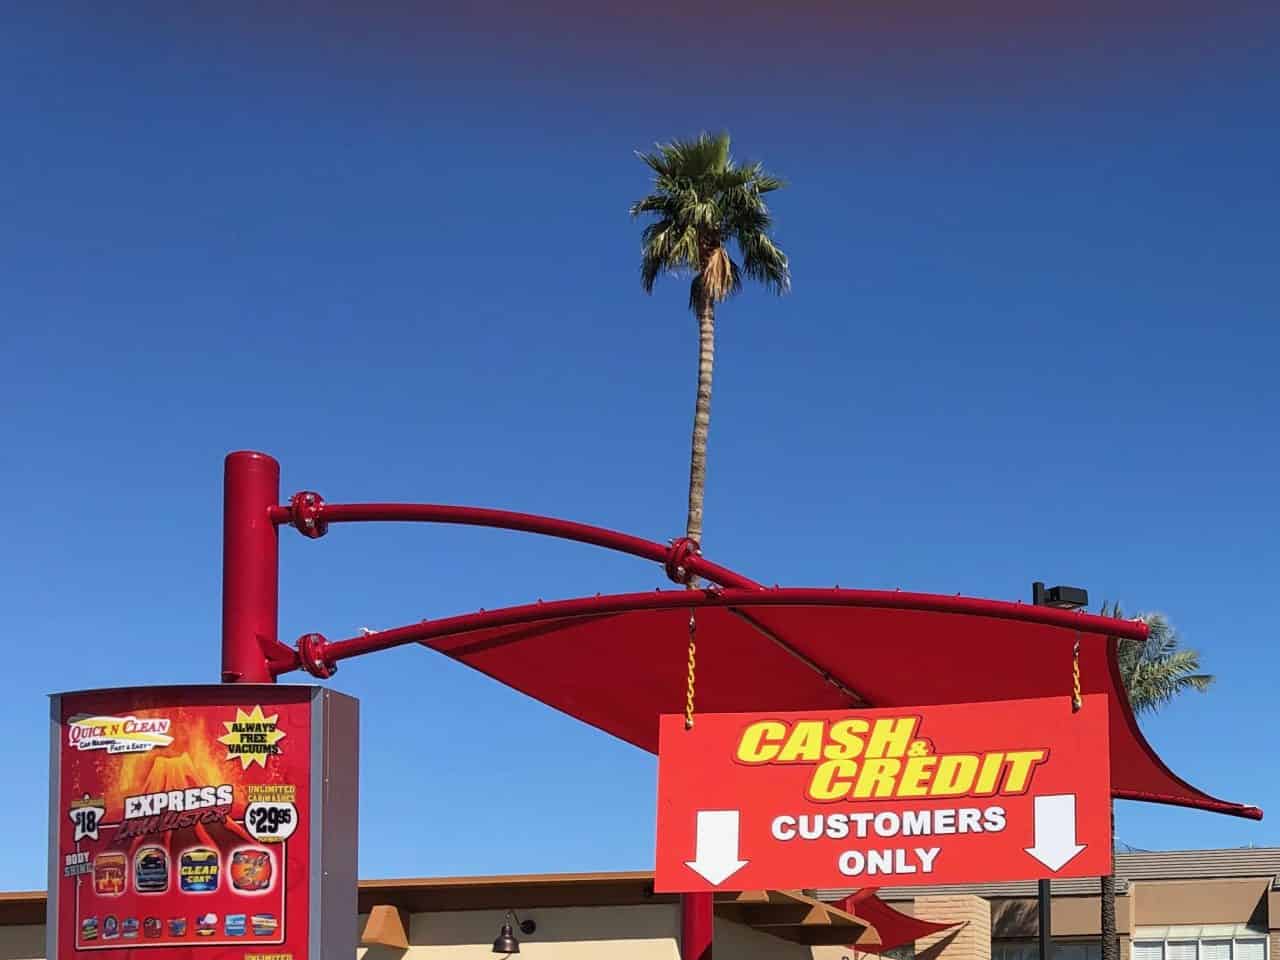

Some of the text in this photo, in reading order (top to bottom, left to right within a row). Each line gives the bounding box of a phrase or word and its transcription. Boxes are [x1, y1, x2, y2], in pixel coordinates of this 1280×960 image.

[123, 720, 168, 734] CLEAN
[231, 723, 276, 733] ALWAYS
[239, 734, 267, 743] FREE
[228, 744, 278, 754] VACUUMS
[737, 717, 932, 763] CASH &
[809, 751, 1047, 801] CREDIT
[125, 785, 233, 819] EXPRESS
[76, 811, 96, 833] $18
[770, 807, 1007, 841] CUSTOMERS
[837, 847, 941, 876] ONLY
